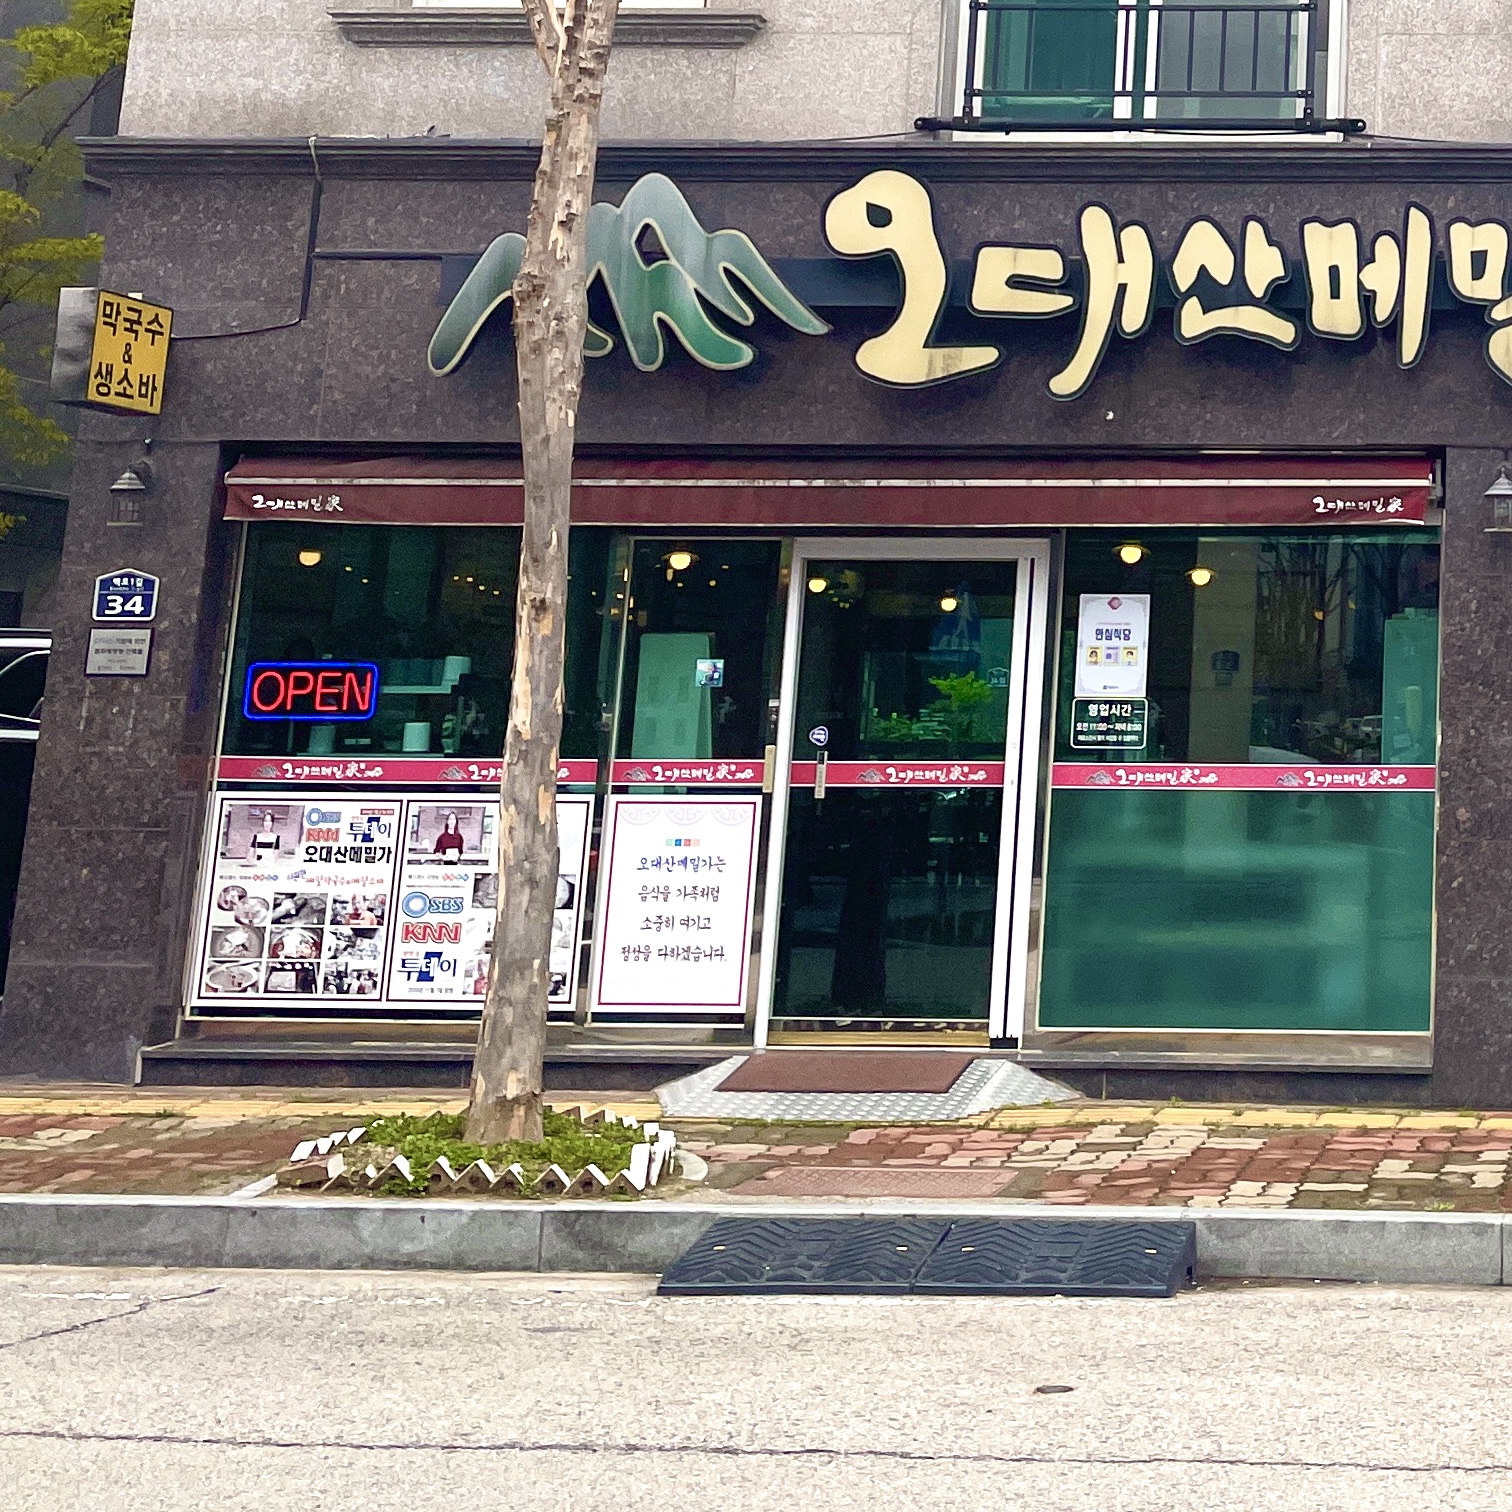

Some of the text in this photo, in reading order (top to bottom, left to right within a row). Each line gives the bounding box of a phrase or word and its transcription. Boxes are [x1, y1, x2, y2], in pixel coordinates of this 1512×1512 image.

[102, 300, 165, 346] 막국수
[122, 342, 133, 365] &
[93, 361, 158, 407] 생소바
[104, 595, 145, 615] 34
[1095, 628, 1132, 641] 안심식당
[252, 671, 372, 711] OPEN
[1088, 703, 1132, 717] 영업시간
[303, 846, 392, 863] 오대산메밀가
[638, 885, 720, 902] 음식을 가족처럼
[429, 897, 463, 913] SBS
[640, 915, 711, 932] 소중히 여기고
[401, 922, 462, 944] KNN
